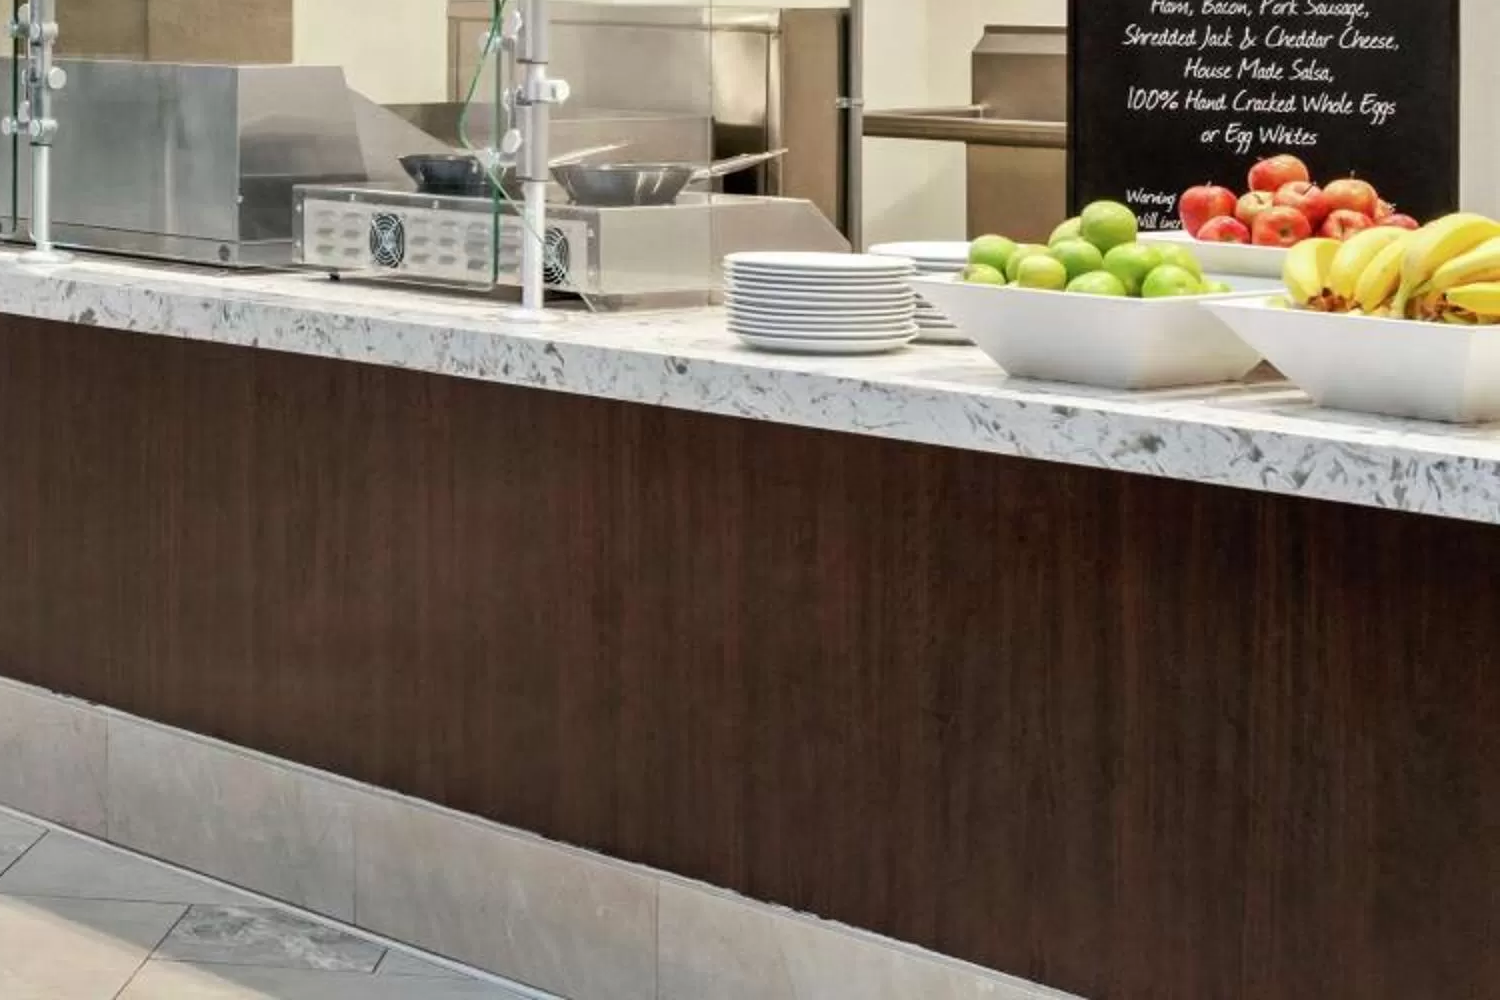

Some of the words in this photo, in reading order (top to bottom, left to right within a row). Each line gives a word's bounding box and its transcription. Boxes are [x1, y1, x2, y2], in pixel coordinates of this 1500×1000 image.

[1123, 24, 1196, 46] Shredded
[1198, 25, 1232, 50] Jack
[1239, 27, 1256, 50] &
[1265, 25, 1334, 48] Cheddar
[1338, 25, 1399, 50] Cheese,
[1184, 57, 1231, 78] House
[1238, 58, 1283, 80] Made
[1290, 58, 1333, 82] Salsa,
[1128, 87, 1178, 110] 100%
[1185, 89, 1227, 110] Hand
[1232, 90, 1296, 112] Cracked
[1303, 92, 1353, 114] Whole
[1360, 94, 1396, 124] Eggs
[1201, 128, 1220, 143] or
[1225, 123, 1252, 153] Egg
[1260, 125, 1317, 145] Whites
